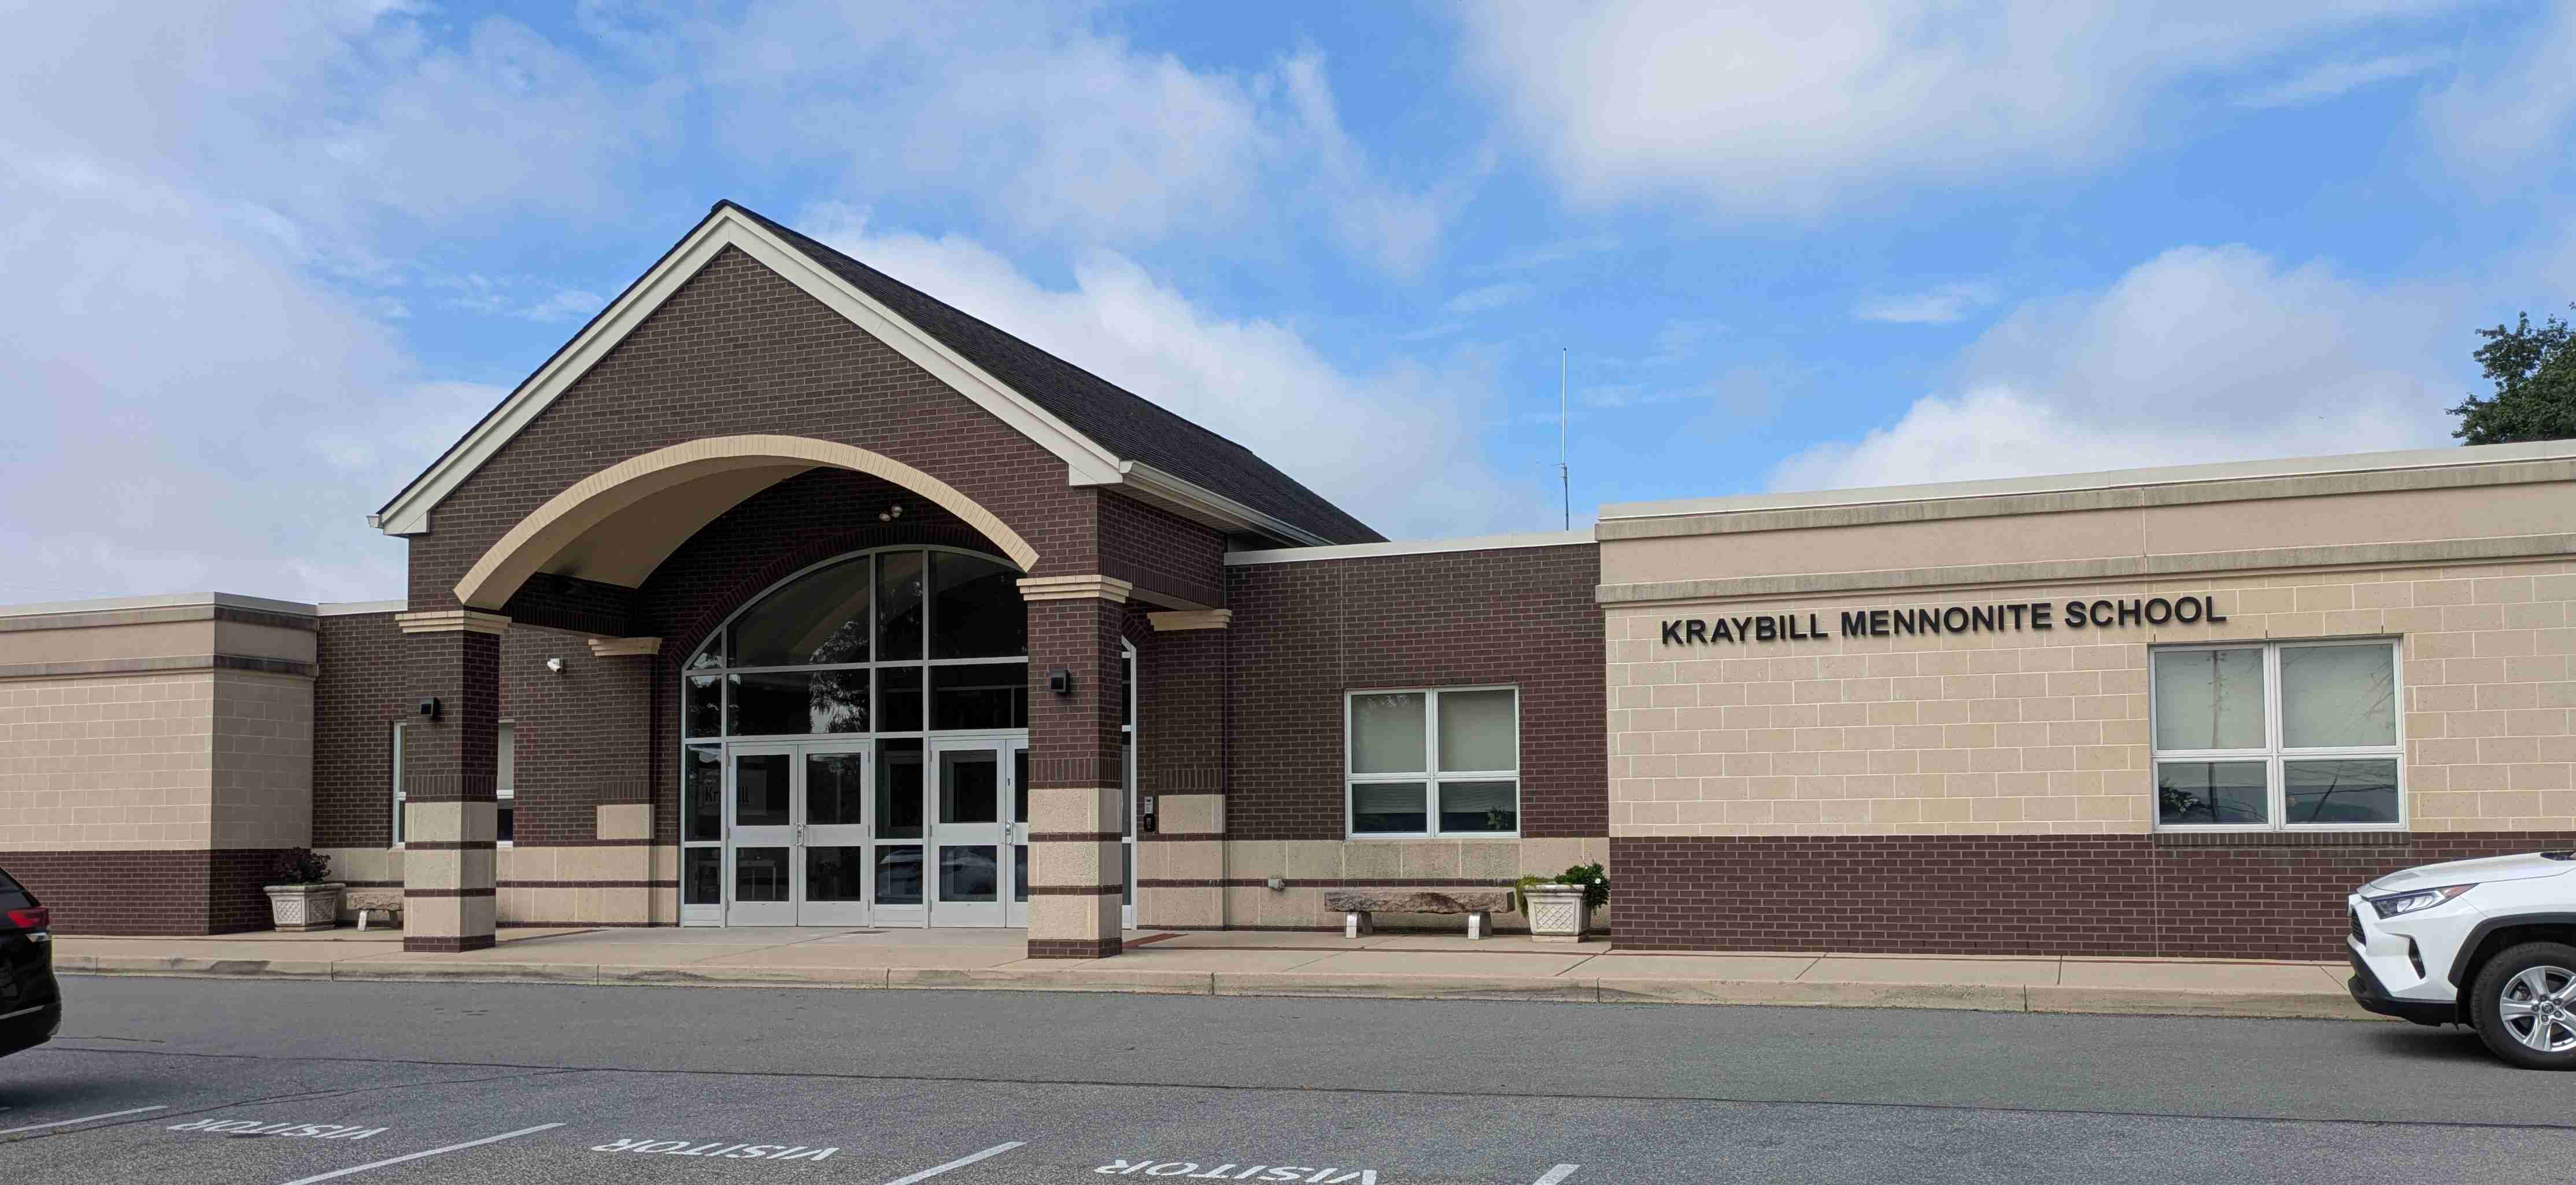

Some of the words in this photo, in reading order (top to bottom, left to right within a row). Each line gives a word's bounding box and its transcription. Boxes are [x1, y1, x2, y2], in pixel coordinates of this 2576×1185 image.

[1661, 614, 1829, 645] KRAYBILL
[1841, 603, 2053, 637] MENNONITE
[2065, 596, 2227, 628] SCHOOL
[167, 1119, 389, 1139] VISITOR
[591, 1138, 840, 1161] VISITOR
[1093, 1159, 1378, 1185] VISITOR
